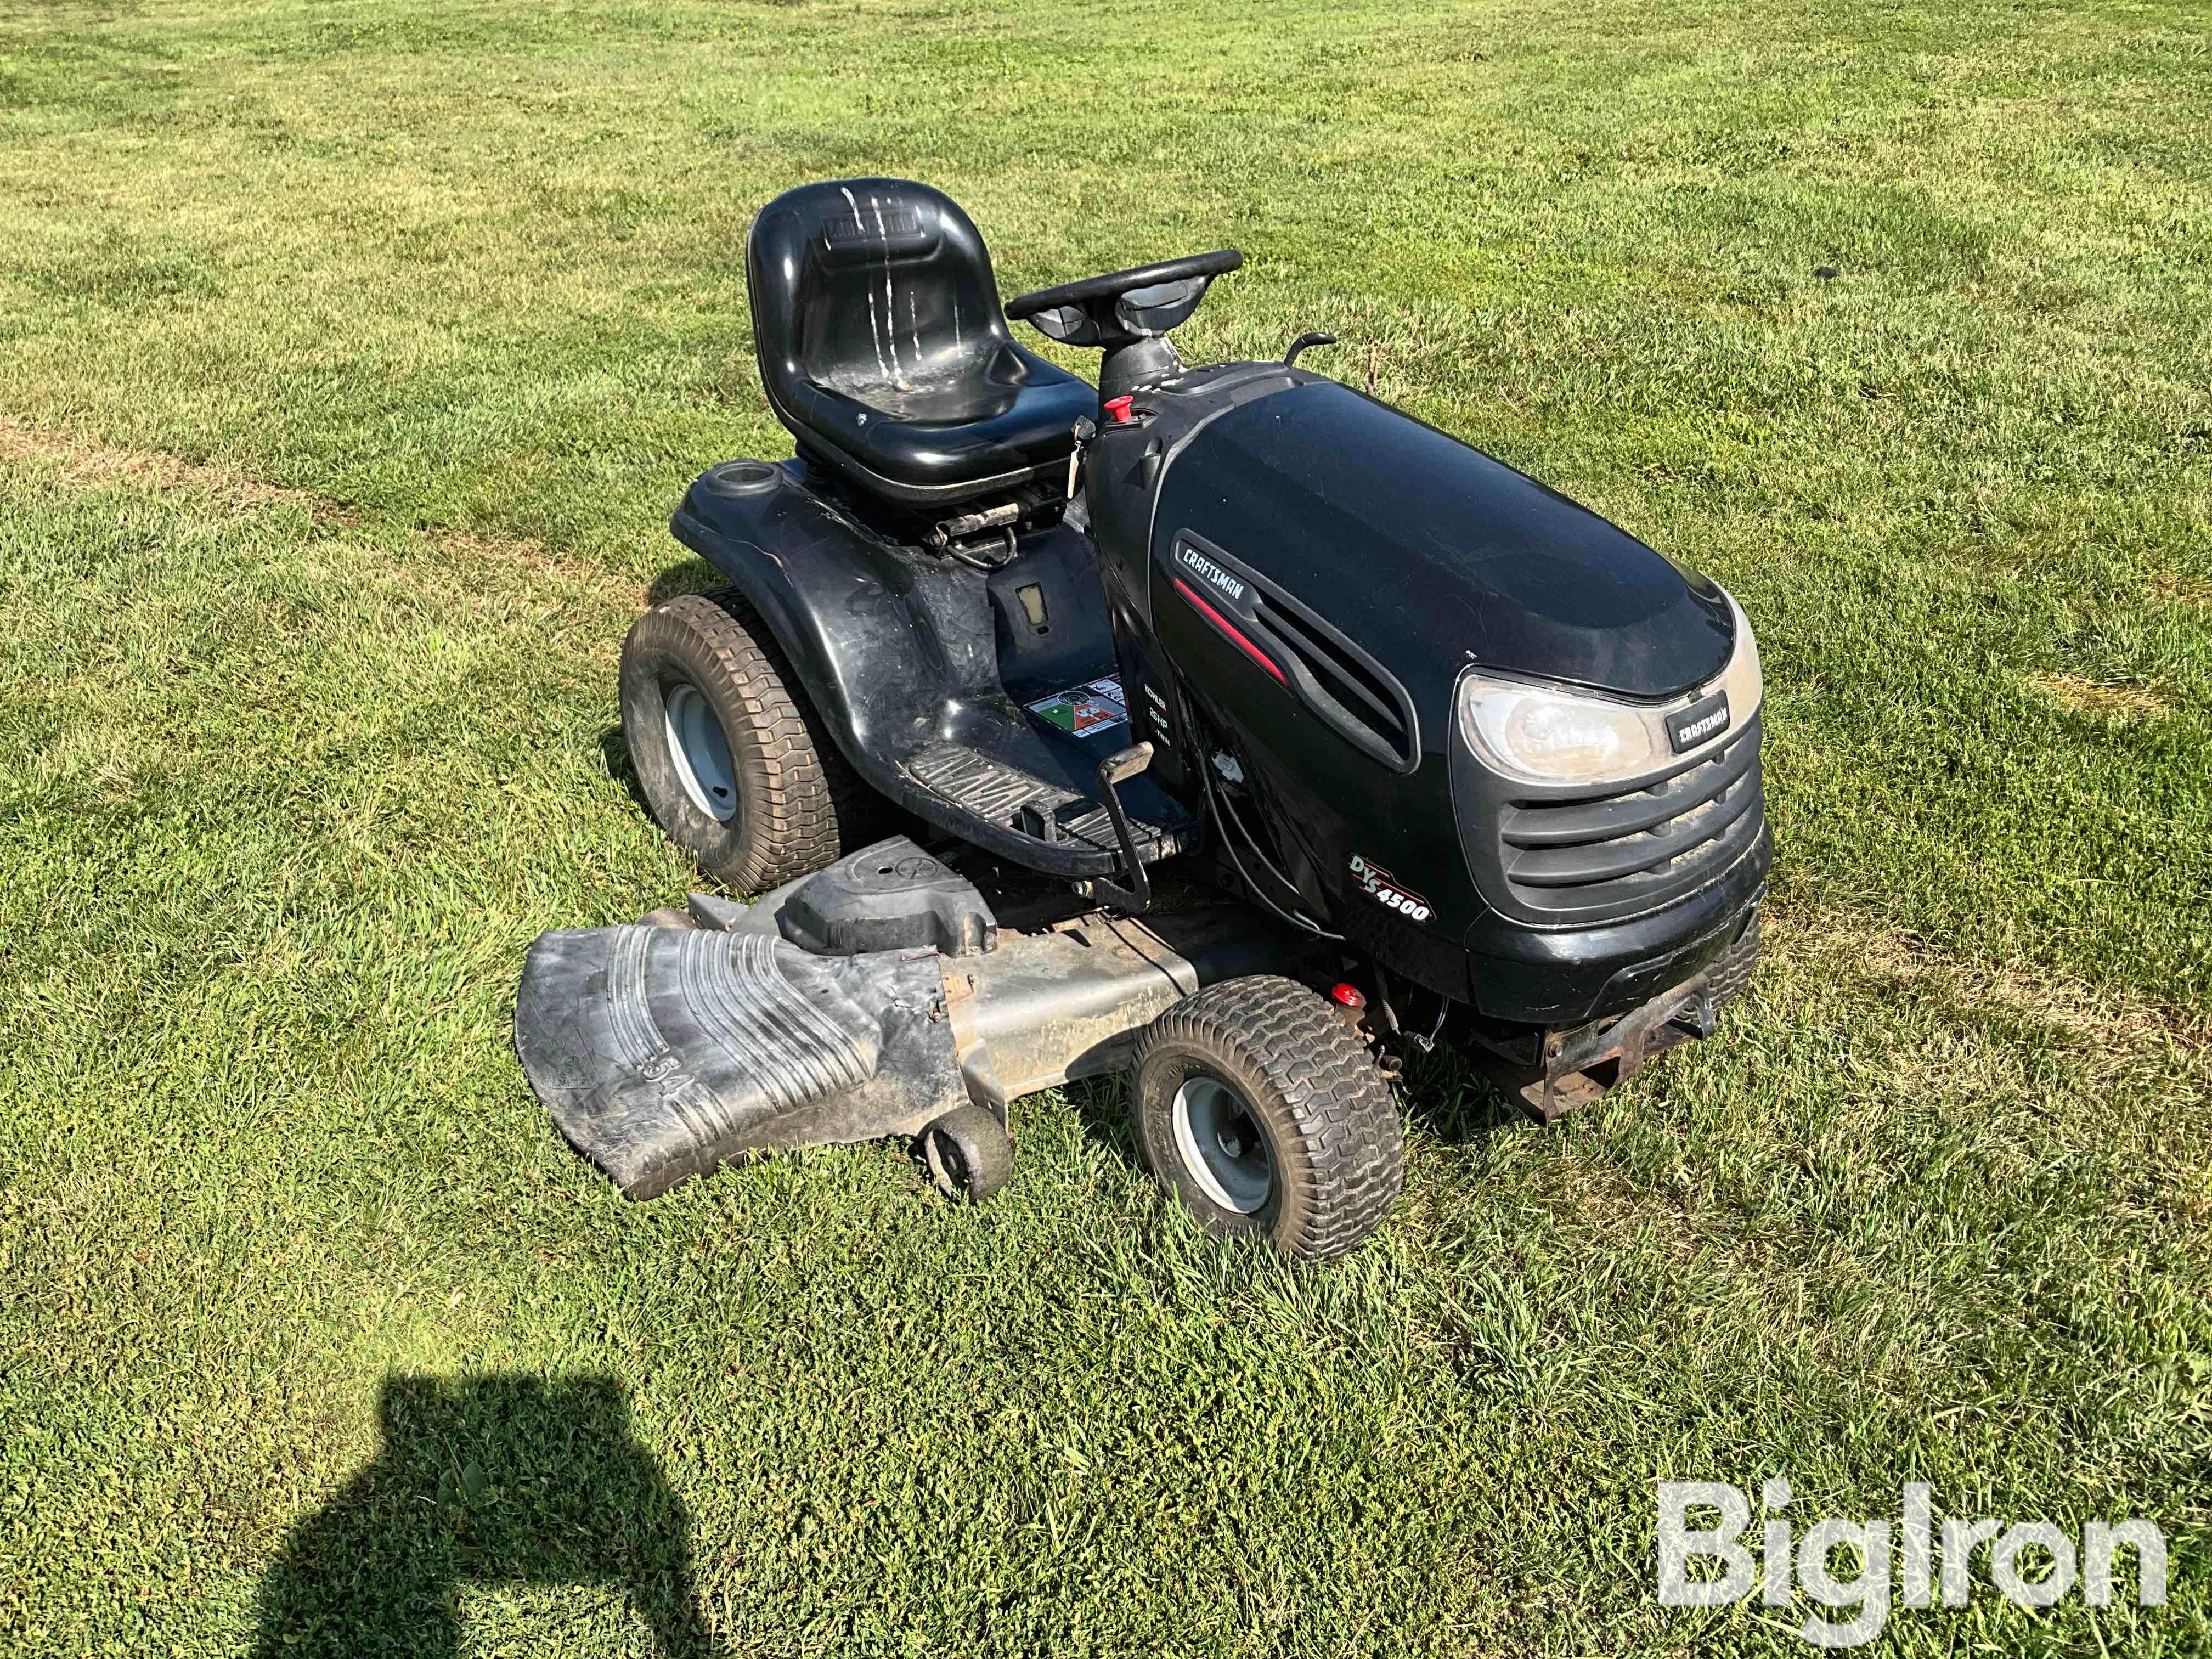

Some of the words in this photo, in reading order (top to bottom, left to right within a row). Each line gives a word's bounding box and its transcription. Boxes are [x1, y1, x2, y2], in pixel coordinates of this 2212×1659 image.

[1183, 549, 1244, 599] CRAFTSMAN
[1144, 683, 1167, 711] KOHLER
[1679, 707, 1728, 743] CRAFTSMAN
[1376, 889, 1430, 921] 4500
